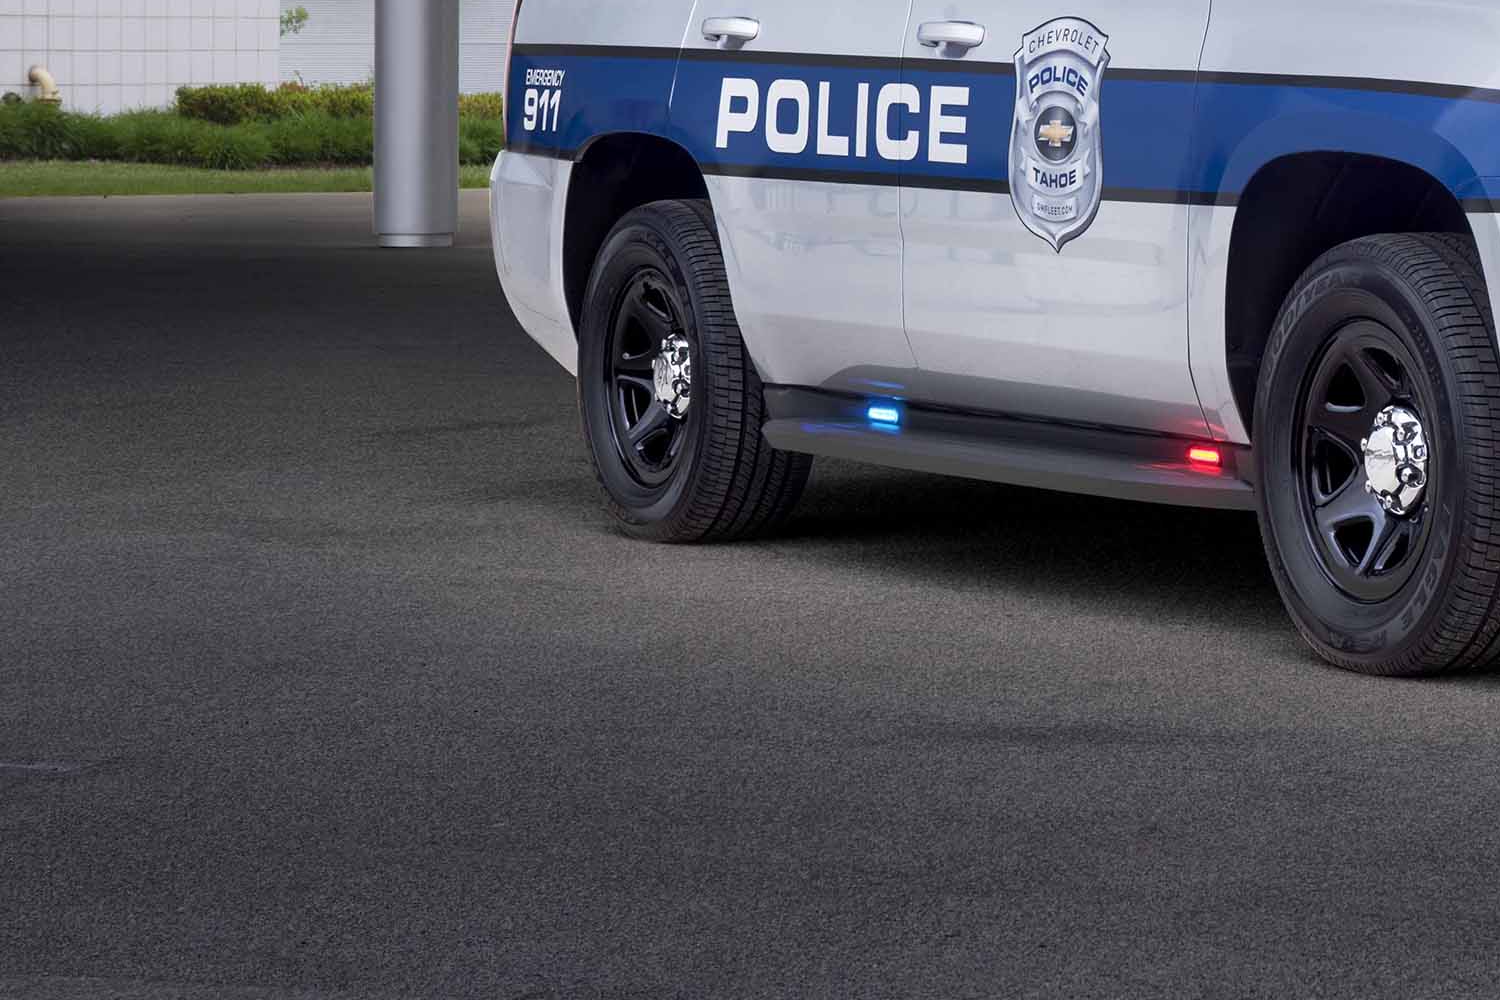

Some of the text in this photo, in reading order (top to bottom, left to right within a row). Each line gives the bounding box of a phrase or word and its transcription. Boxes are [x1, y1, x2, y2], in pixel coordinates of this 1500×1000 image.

[1028, 28, 1099, 54] CHEVROLET
[525, 68, 566, 87] EMERGENCY
[1028, 65, 1089, 97] POLICE
[523, 88, 562, 132] 911
[714, 77, 970, 165] POLICE
[1032, 167, 1077, 189] TAHOE
